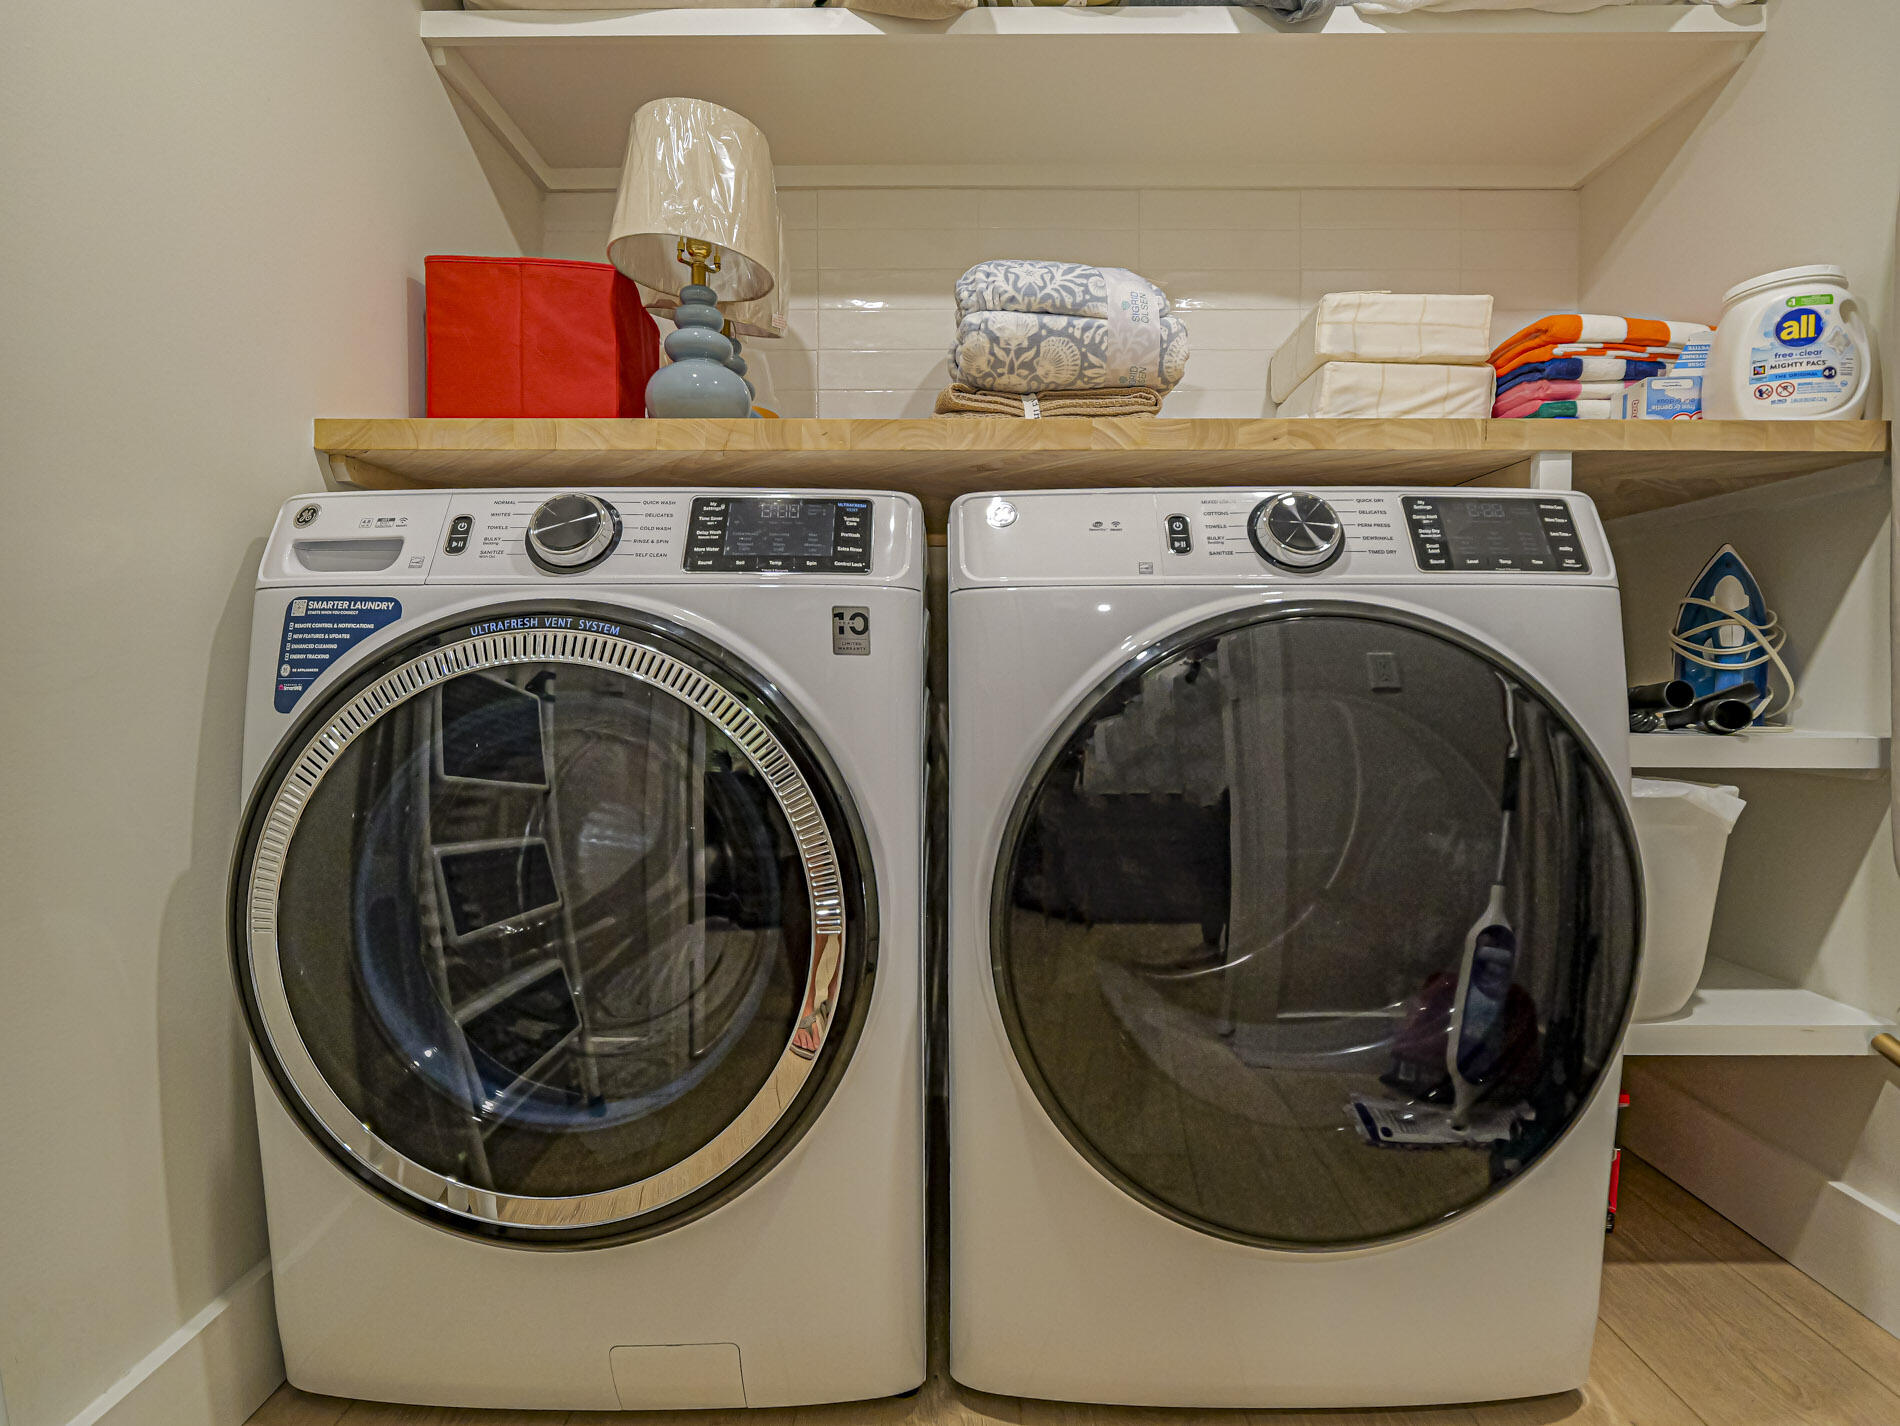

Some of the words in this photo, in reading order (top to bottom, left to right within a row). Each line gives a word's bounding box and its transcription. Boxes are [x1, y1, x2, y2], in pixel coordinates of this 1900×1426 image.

[1130, 292, 1140, 322] SIGRID
[1140, 294, 1149, 324] OLSEN
[1780, 314, 1816, 340] all
[1138, 366, 1147, 384] SEN
[1770, 361, 1804, 370] MIGHTY
[1129, 366, 1138, 387] GRID
[308, 601, 349, 609] SMARTER
[350, 602, 394, 610] LAUNDRY
[470, 618, 538, 636] ULTRAFRESH
[544, 618, 572, 628] VENT
[579, 619, 621, 635] SYSTEM
[834, 612, 868, 635] 10
